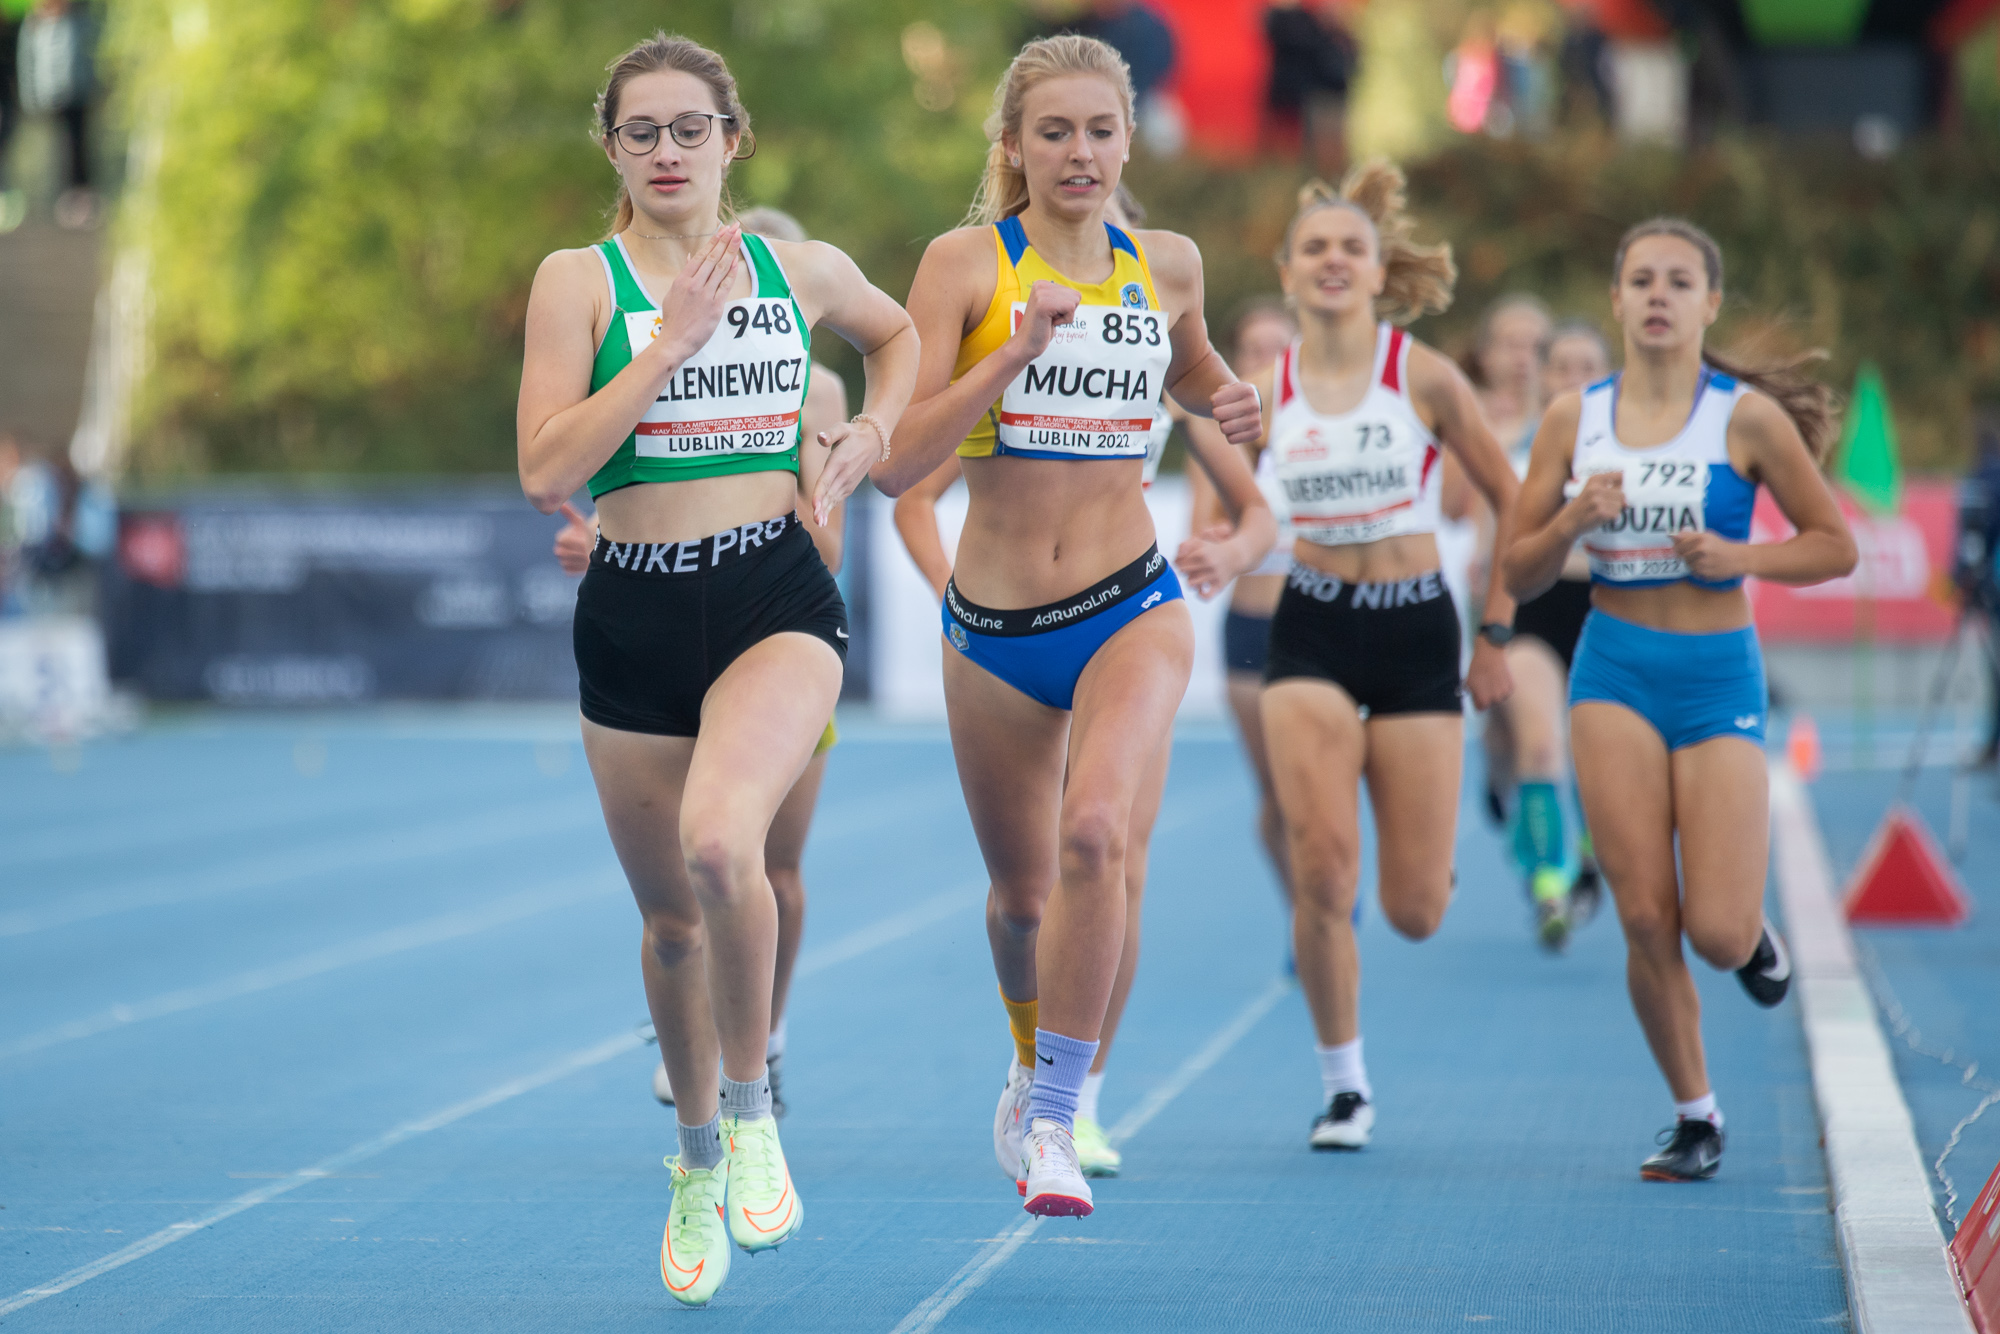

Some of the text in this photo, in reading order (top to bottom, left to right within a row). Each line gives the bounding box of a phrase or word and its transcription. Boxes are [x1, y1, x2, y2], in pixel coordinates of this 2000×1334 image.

[727, 303, 792, 339] 948
[1102, 313, 1161, 346] 853
[1024, 364, 1148, 400] MUCHA
[671, 422, 691, 430] PZLA
[692, 418, 743, 429] MISTRZOSTWA
[744, 416, 769, 424] POLSKI
[712, 422, 747, 432] JANUSZA
[669, 430, 785, 452] LUBLIN 2022
[1029, 430, 1130, 448] LUBLIN 2022
[1353, 424, 1392, 452] 73
[1639, 463, 1695, 487] 792
[604, 516, 787, 574] NIKE PRO
[1640, 560, 1682, 576] 2022
[1351, 572, 1443, 610] NIKE
[1031, 584, 1122, 628] AdRunaLine
